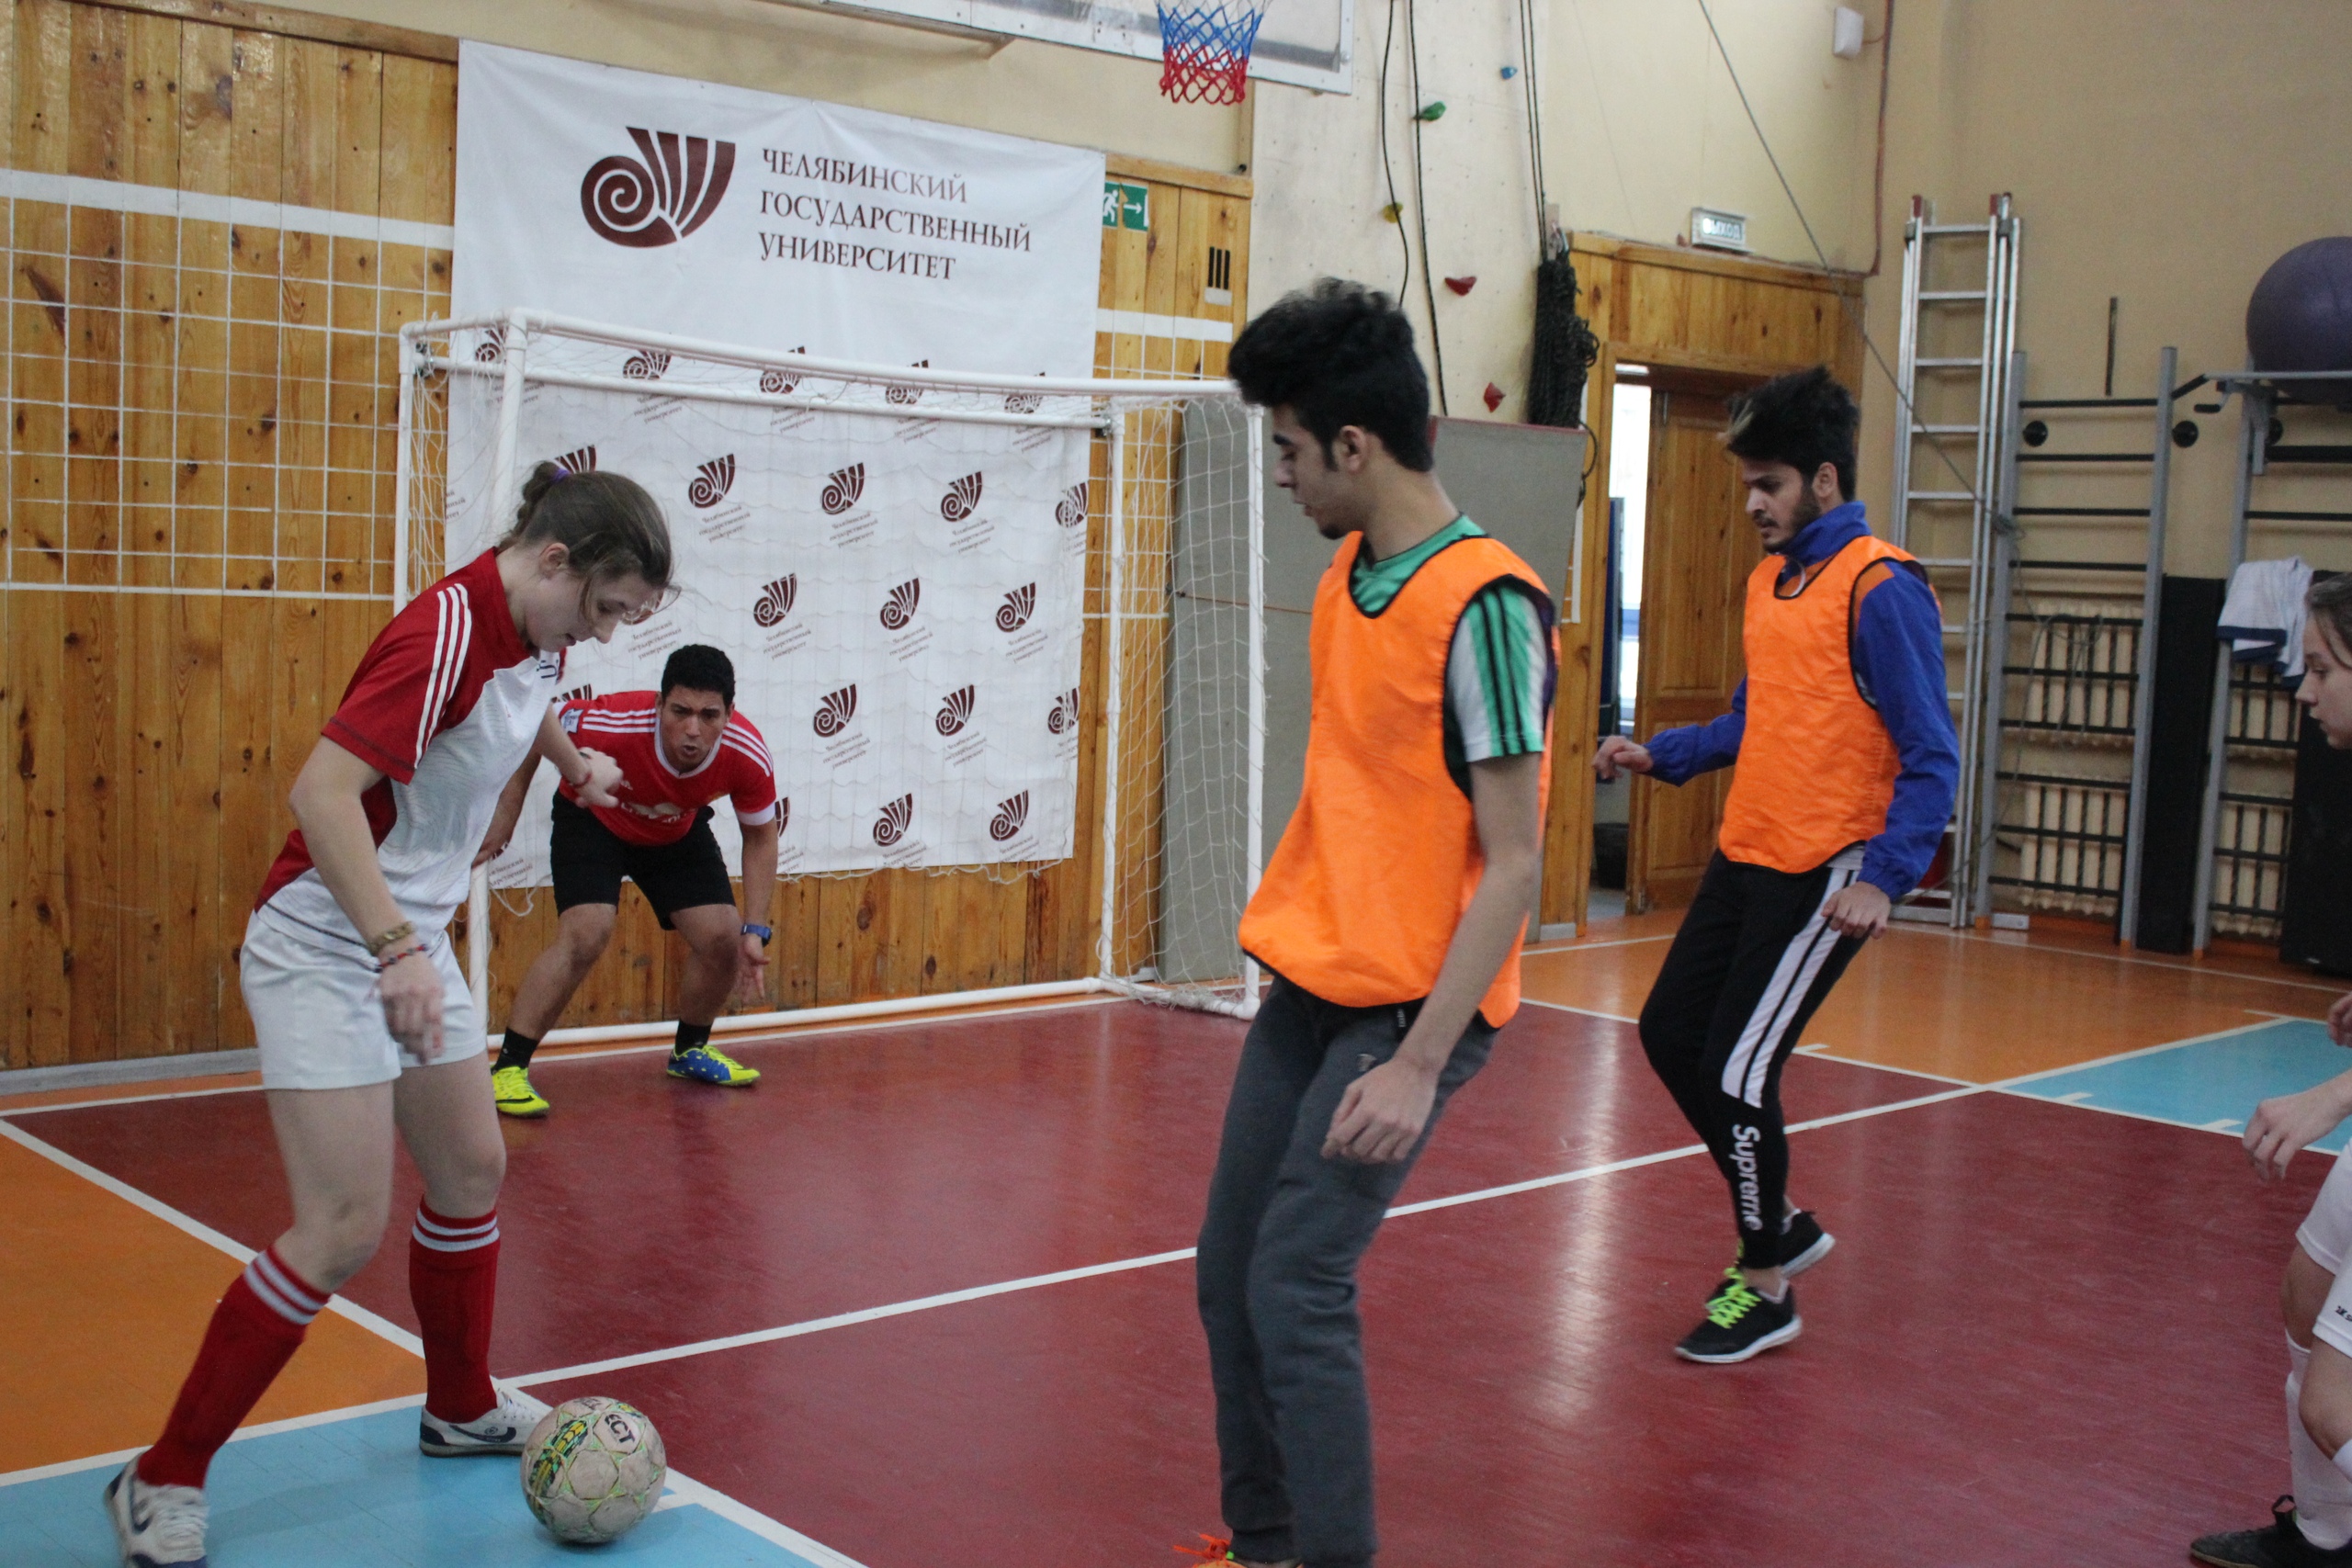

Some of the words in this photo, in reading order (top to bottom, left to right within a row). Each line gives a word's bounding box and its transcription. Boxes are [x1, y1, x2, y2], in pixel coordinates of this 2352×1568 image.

[762, 148, 967, 204] ЧЕЛЯБИНСКИЙ
[760, 189, 1032, 253] ГОСУДАРСТВЕННЫЙ
[758, 231, 956, 280] УНИВЕРСИТЕТ
[1728, 1122, 1764, 1231] Supreme
